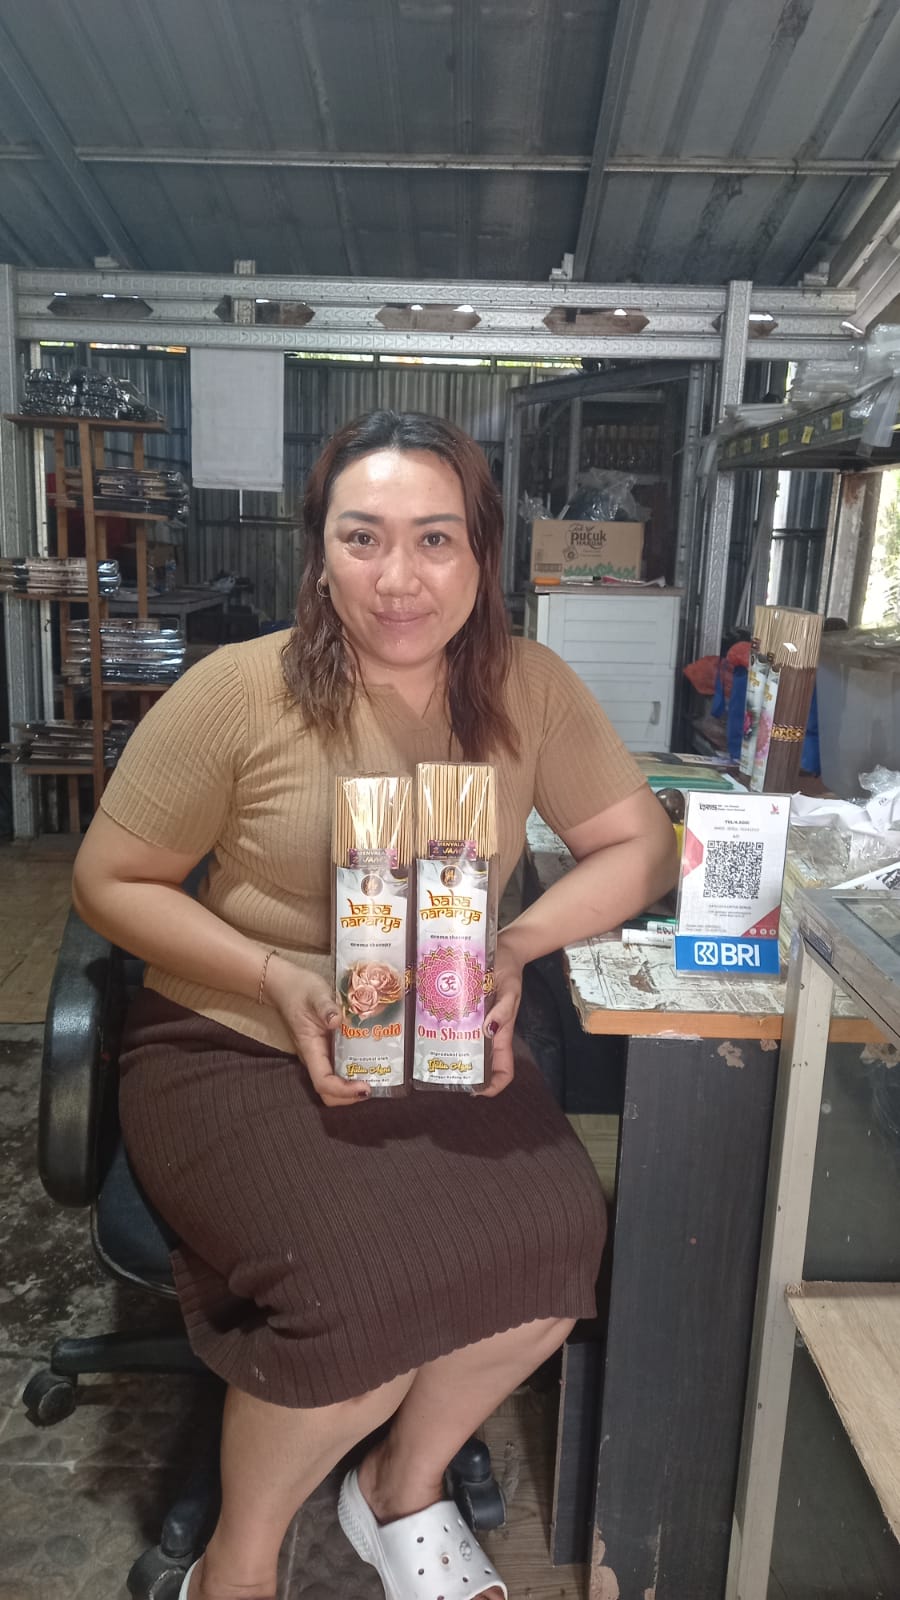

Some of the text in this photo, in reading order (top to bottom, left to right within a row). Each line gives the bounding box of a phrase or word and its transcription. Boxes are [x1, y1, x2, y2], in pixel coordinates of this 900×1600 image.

[570, 530, 607, 545] pucuk
[347, 898, 393, 916] baba
[427, 889, 472, 908] baba
[340, 916, 403, 934] nararya
[419, 907, 483, 926] nararya
[720, 943, 760, 967] BRI
[341, 1023, 402, 1041] Rose Gold
[418, 1025, 481, 1041] Om Shanti
